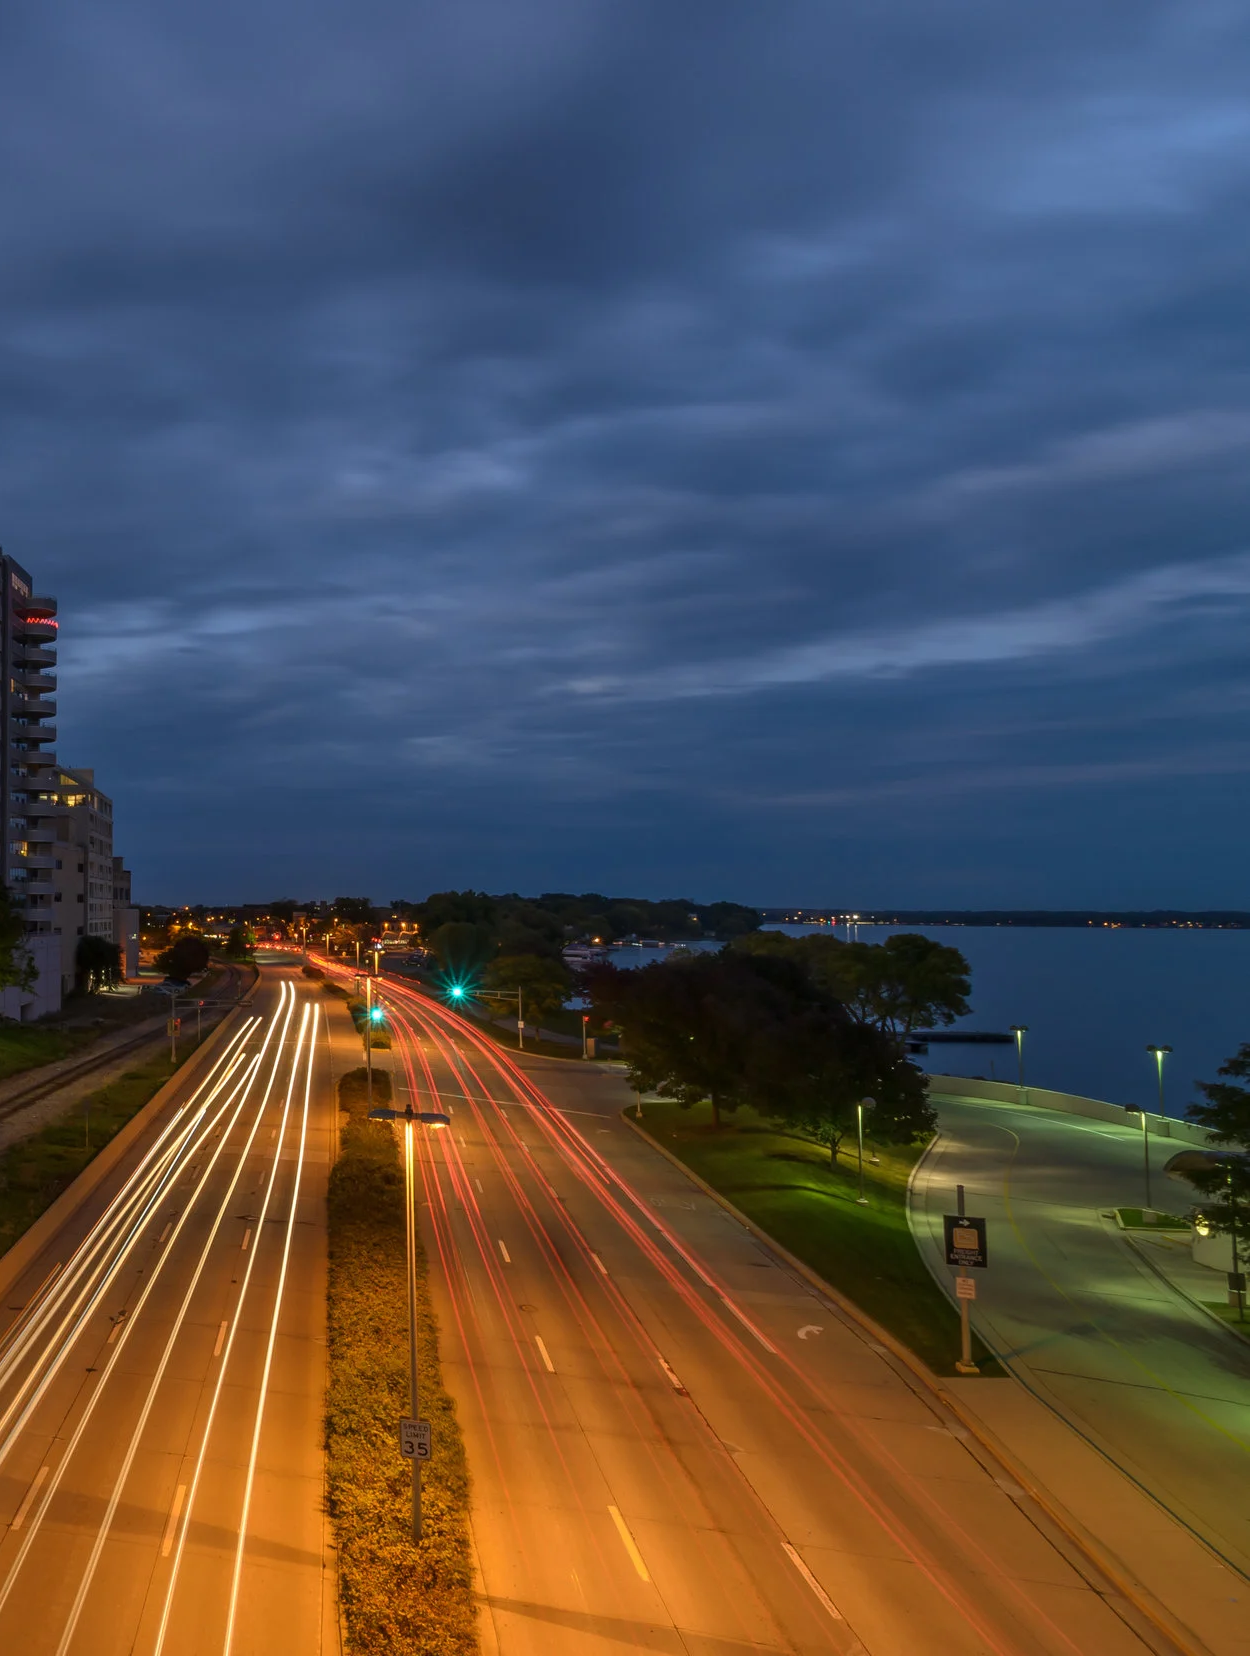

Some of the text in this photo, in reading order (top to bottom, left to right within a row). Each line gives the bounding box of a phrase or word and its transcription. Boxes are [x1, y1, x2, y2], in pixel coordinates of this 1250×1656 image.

[950, 1253, 983, 1262] ENTRANCE
[403, 1423, 429, 1433] SPEED
[406, 1431, 426, 1439] LIMIT
[404, 1440, 428, 1456] 35
